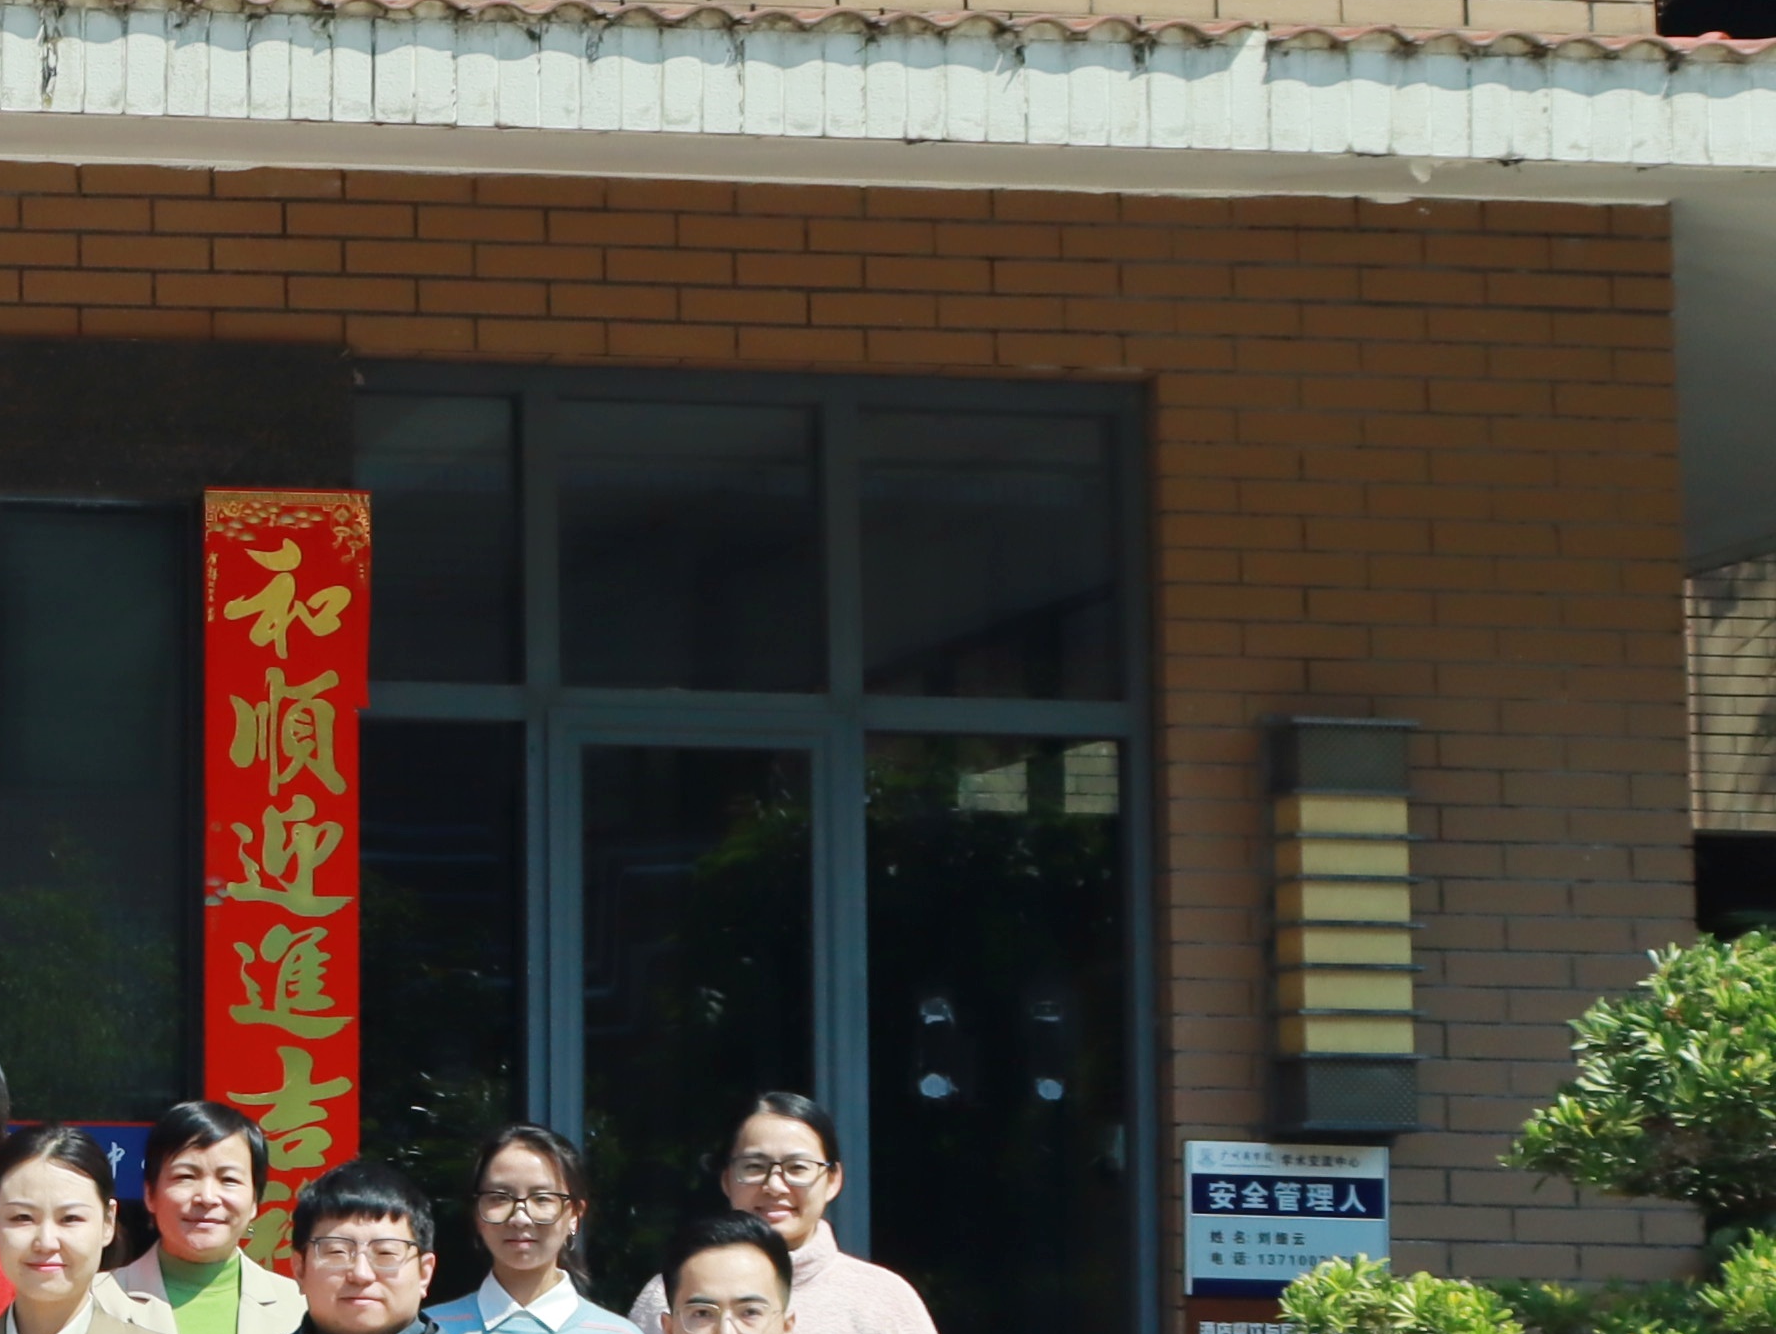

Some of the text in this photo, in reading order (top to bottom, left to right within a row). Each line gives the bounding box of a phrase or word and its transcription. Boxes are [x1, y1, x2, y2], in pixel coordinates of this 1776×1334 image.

[1208, 1181, 1367, 1214] 安全管理人
